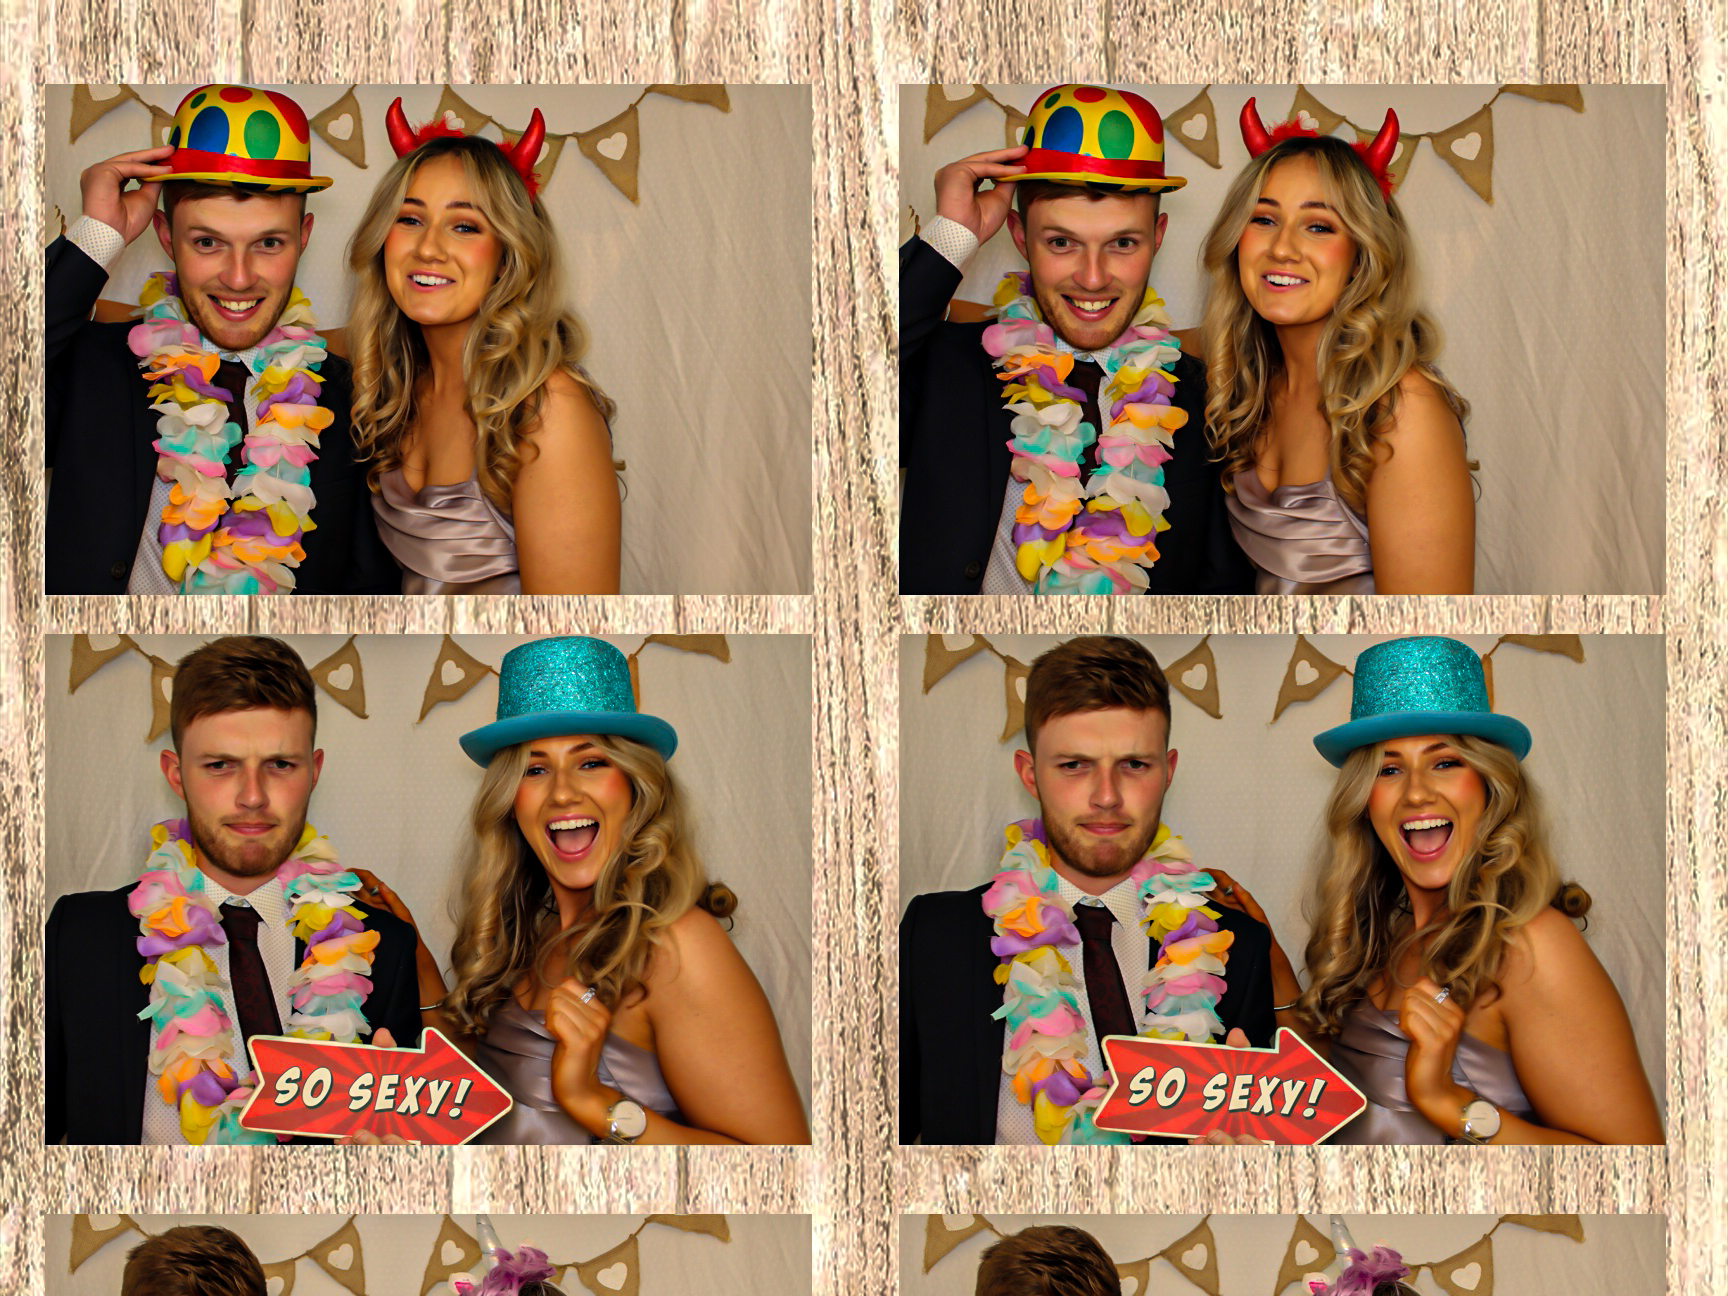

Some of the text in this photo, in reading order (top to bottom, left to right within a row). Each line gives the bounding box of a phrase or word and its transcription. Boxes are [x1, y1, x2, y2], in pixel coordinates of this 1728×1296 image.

[273, 1066, 474, 1120] SO SEXY!
[1128, 1066, 1329, 1120] SO SEXY!
